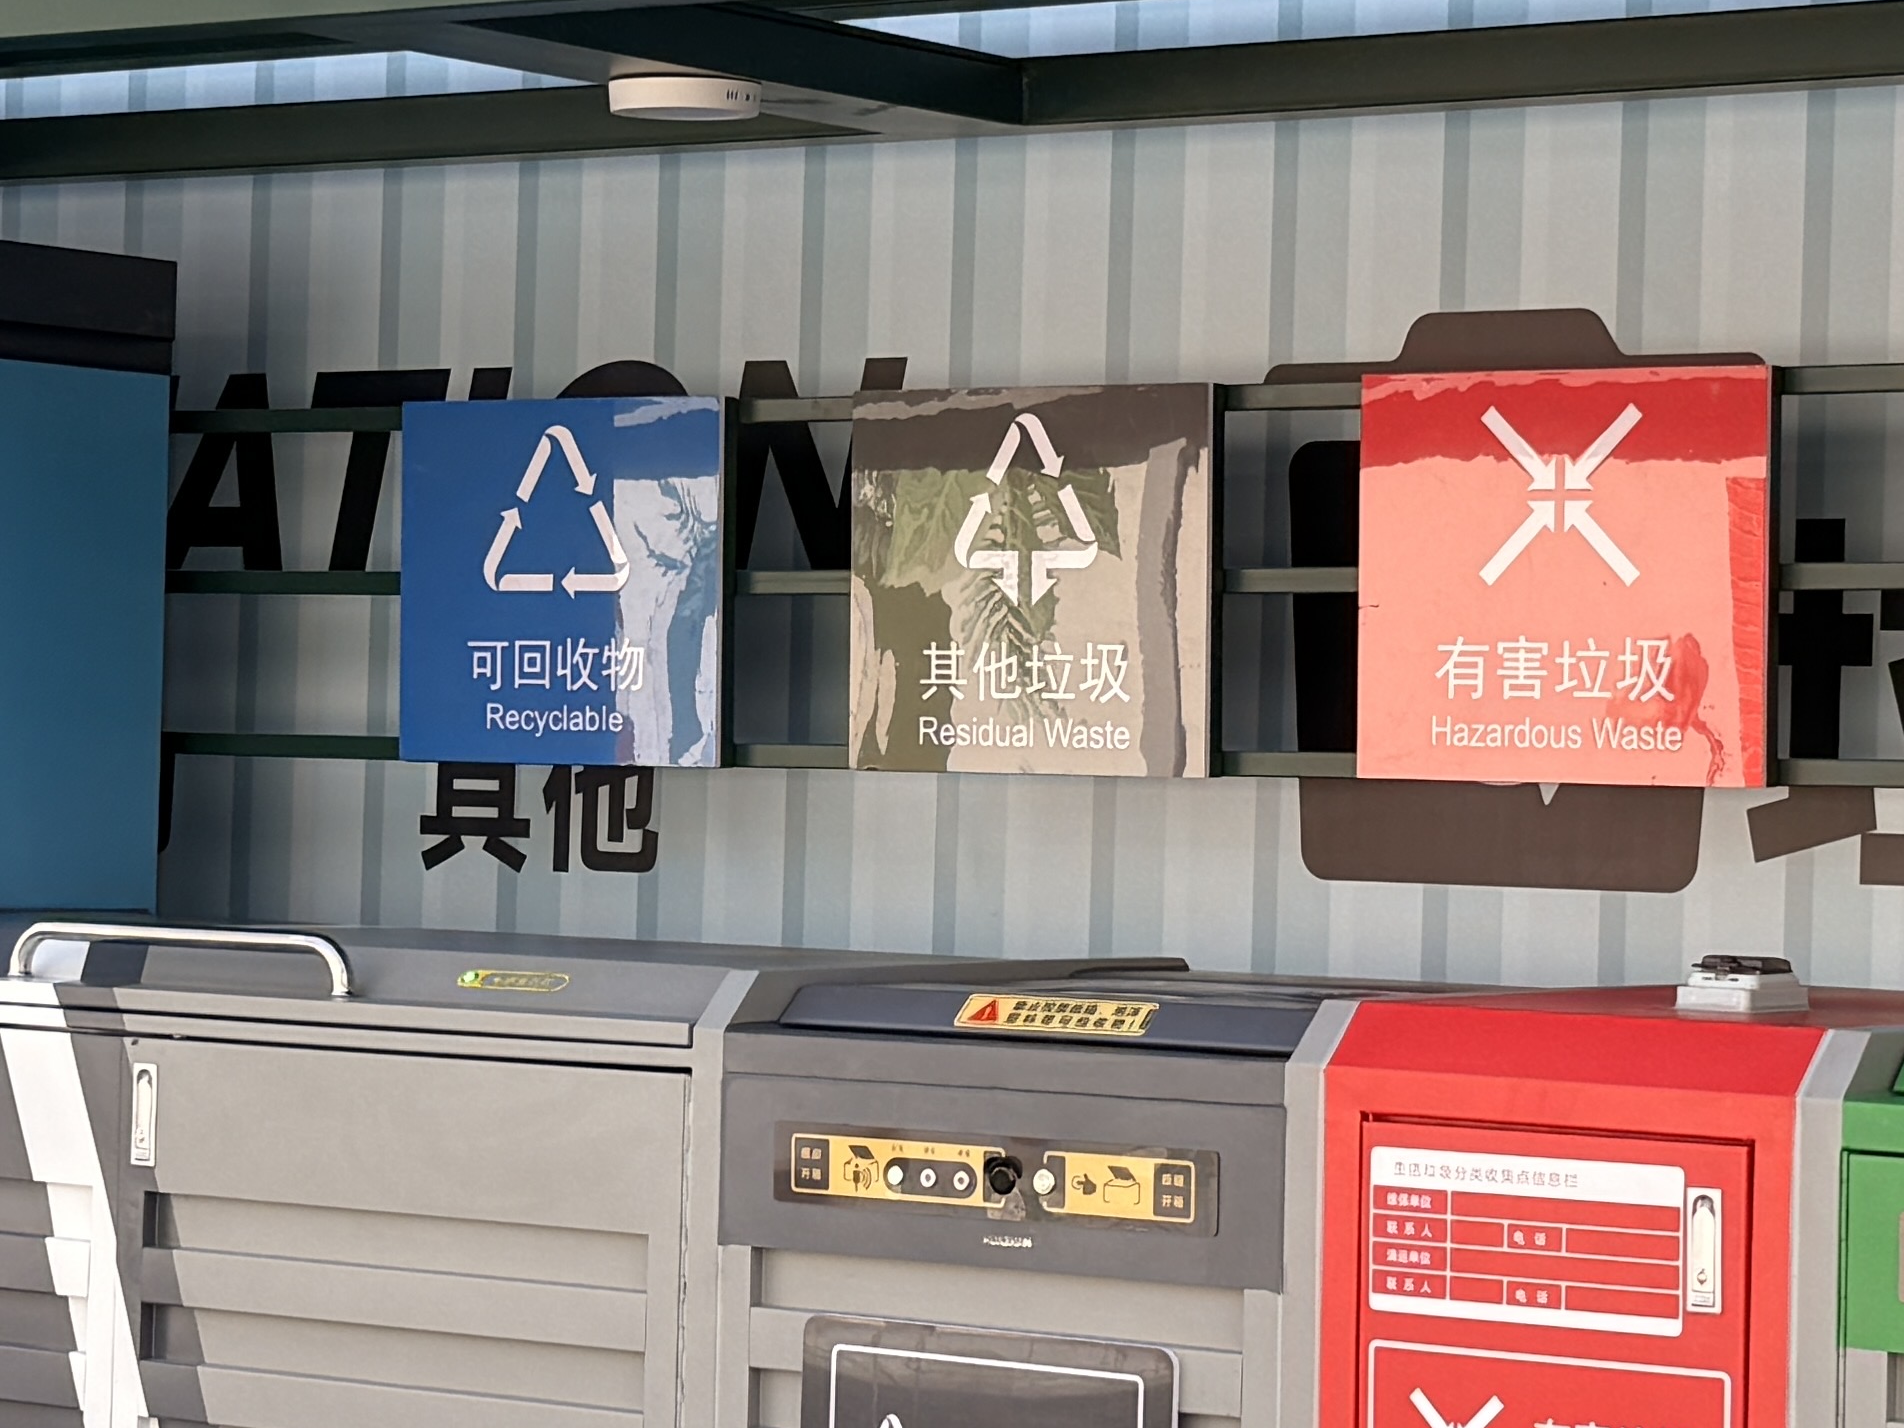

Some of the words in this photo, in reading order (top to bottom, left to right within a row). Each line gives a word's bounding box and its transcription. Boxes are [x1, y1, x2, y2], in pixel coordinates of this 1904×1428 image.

[468, 636, 644, 693] 可回收物
[919, 640, 1131, 706] 其他垃圾
[1434, 639, 1676, 703] 有害垃圾
[485, 701, 624, 738] Recyclable
[918, 715, 1034, 748] Residual
[1043, 719, 1131, 751] Waste
[1429, 713, 1584, 751] Hazardous
[1591, 716, 1683, 753] Waste
